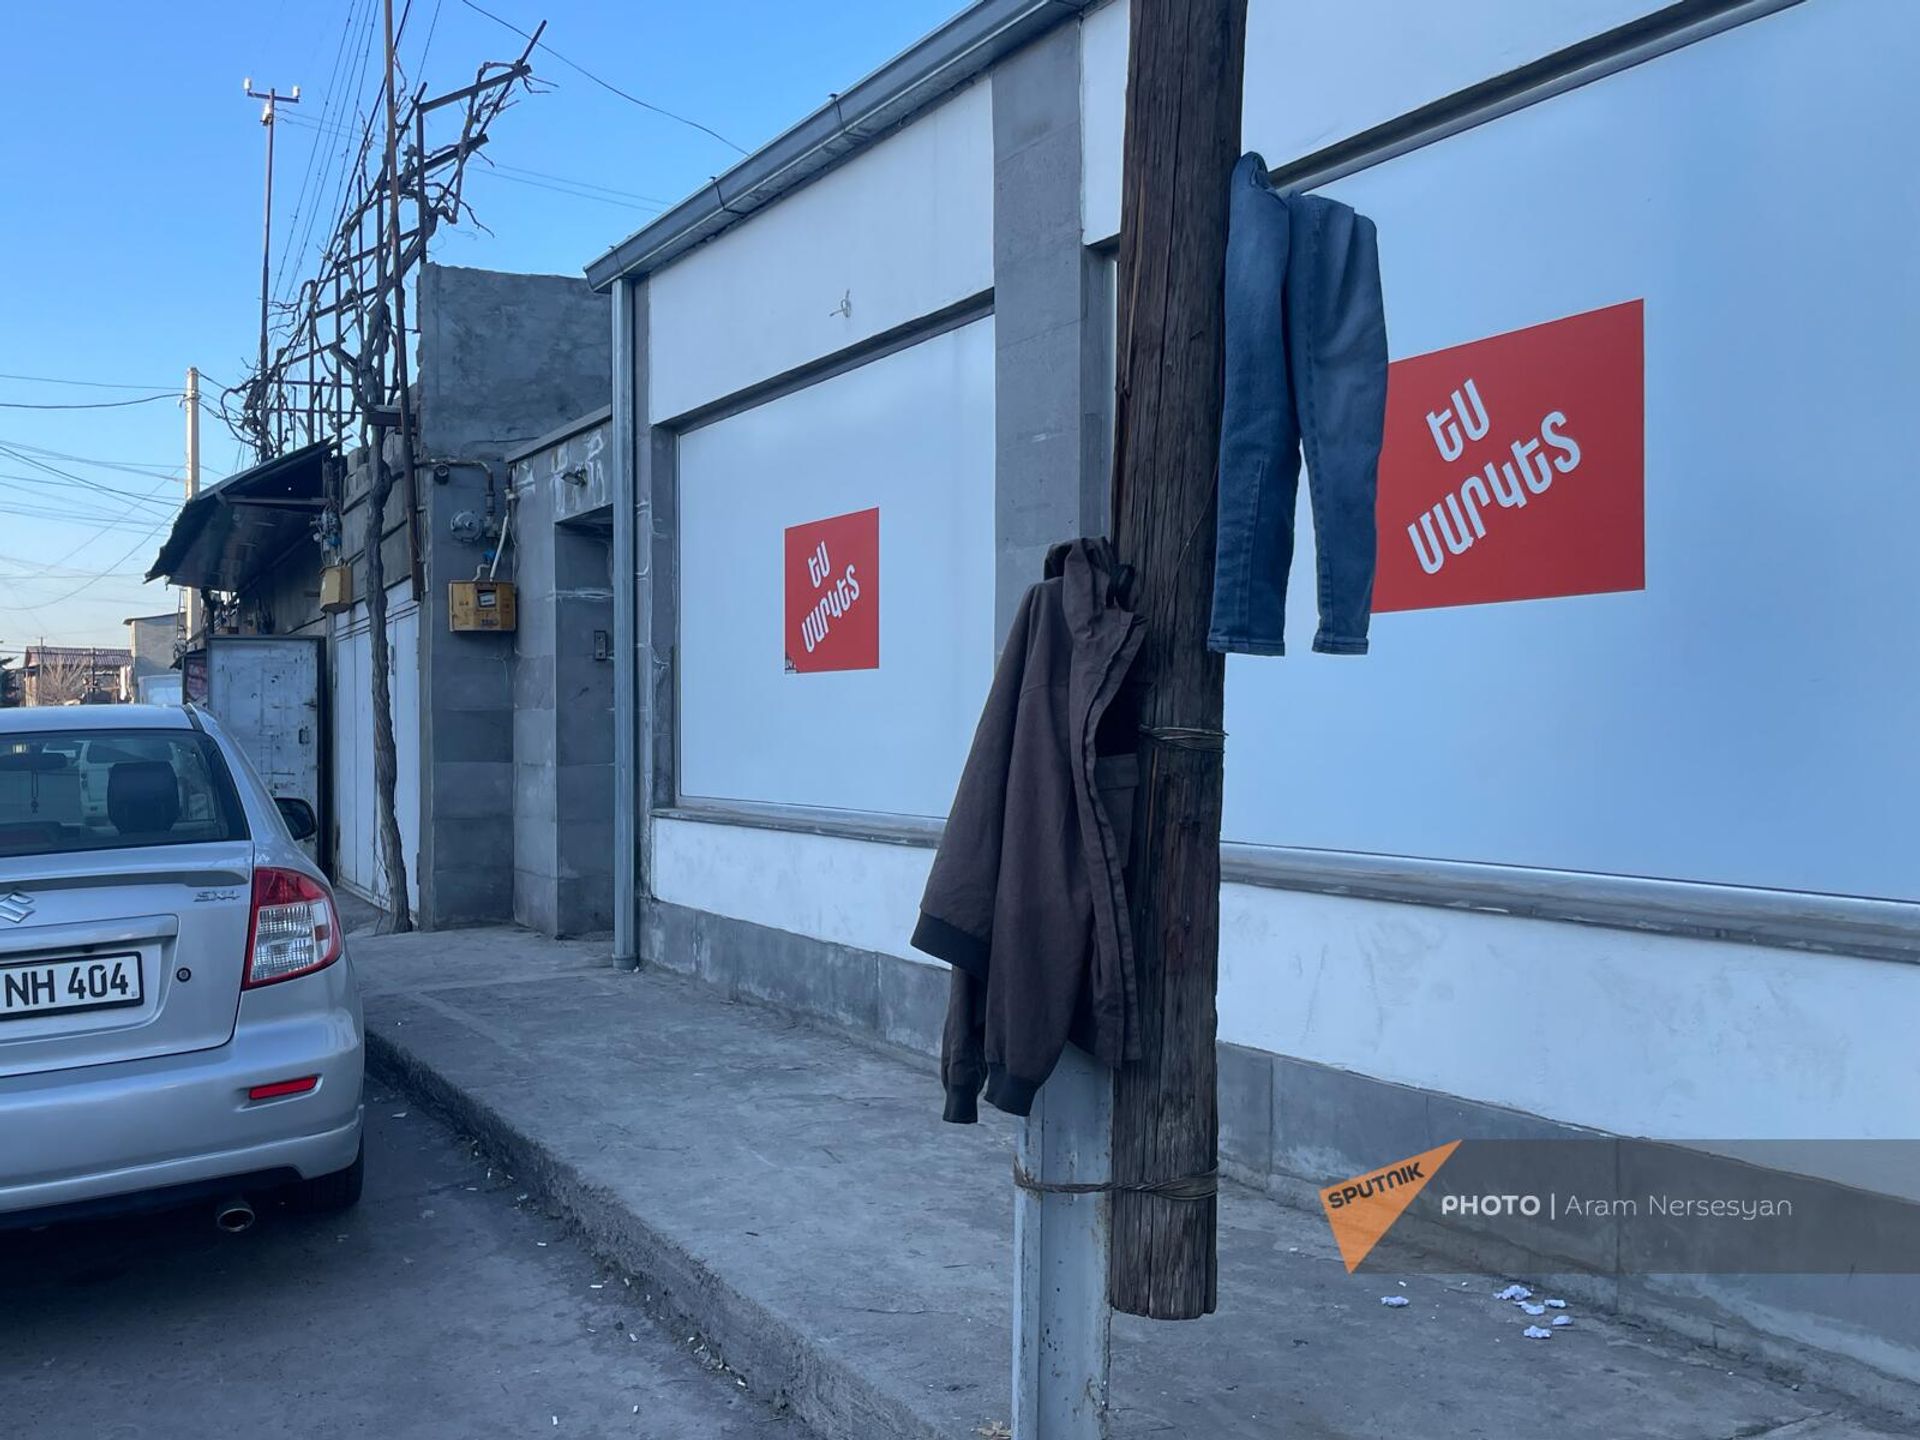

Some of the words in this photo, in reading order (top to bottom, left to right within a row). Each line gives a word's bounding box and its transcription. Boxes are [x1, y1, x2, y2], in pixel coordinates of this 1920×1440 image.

[1425, 378, 1491, 463] ԵՍ
[1407, 411, 1581, 575] ՄԱՐԿԵՏ
[801, 565, 860, 653] ՄԱՐԿԵՏ
[193, 890, 240, 902] SX4
[5, 969, 55, 1008] NH
[68, 962, 128, 999] 404
